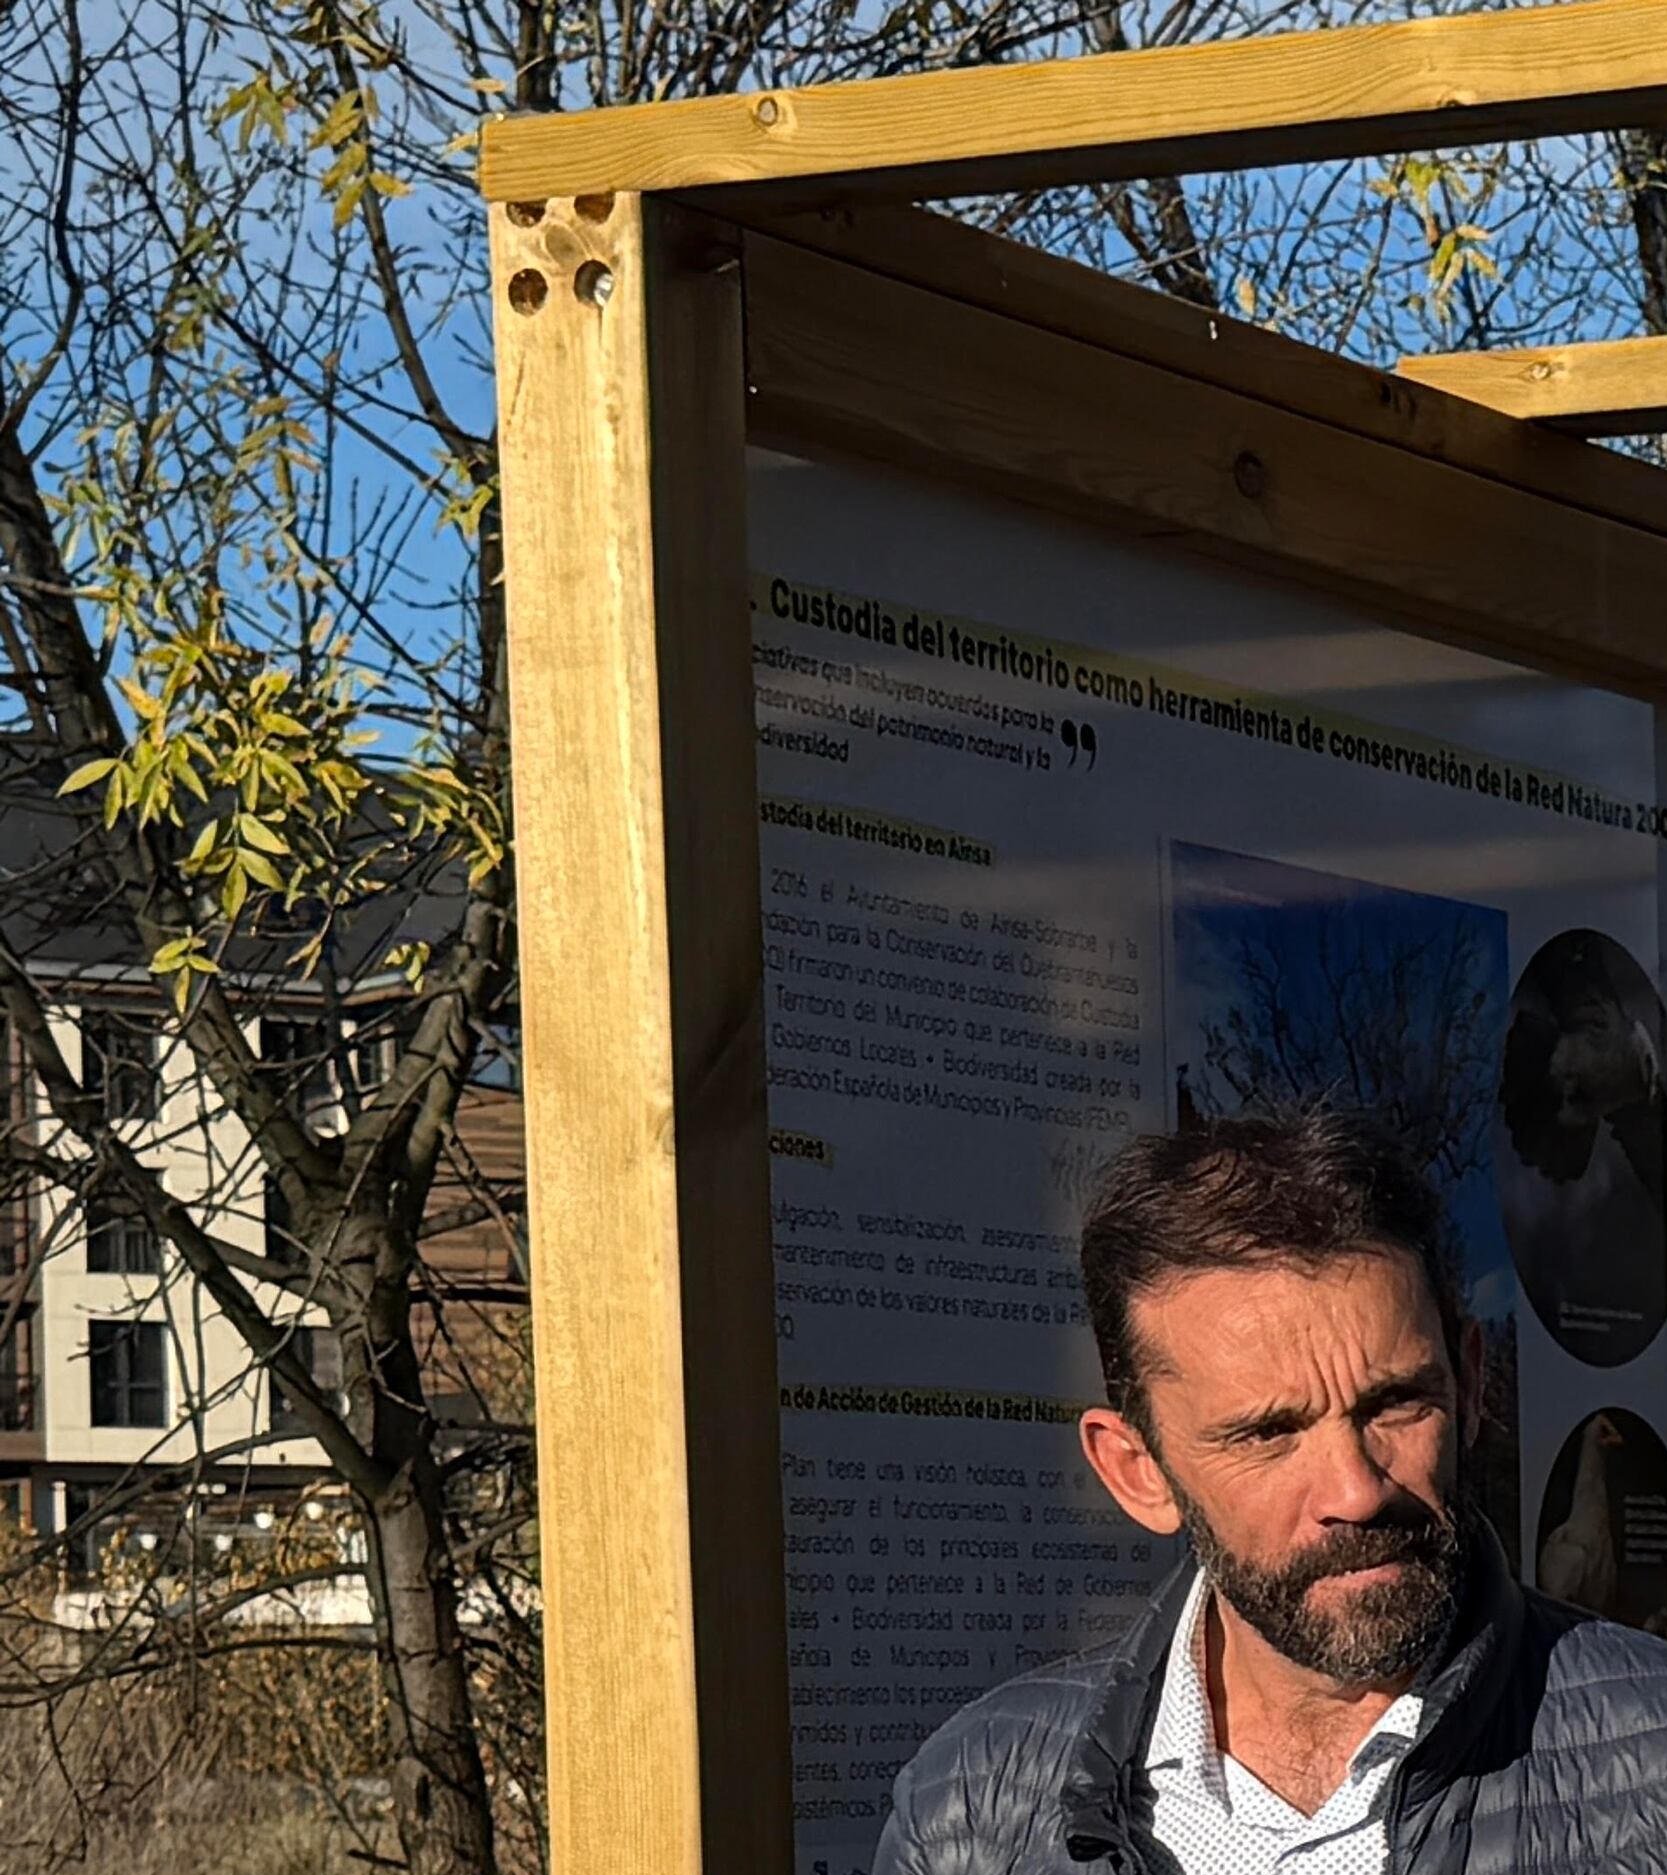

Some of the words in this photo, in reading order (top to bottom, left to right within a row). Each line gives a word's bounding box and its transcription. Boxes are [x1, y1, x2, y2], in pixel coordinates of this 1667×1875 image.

[769, 577, 898, 647] Custodia
[902, 612, 945, 659] del
[948, 625, 1070, 690] territorio
[1074, 665, 1144, 709] como
[1148, 675, 1293, 746] herramienta
[1296, 715, 1325, 755] de
[1328, 729, 1473, 791] conservación
[1475, 762, 1502, 798] de
[1503, 767, 1524, 804] la
[1526, 772, 1565, 815] Red
[1567, 783, 1634, 831] Natura
